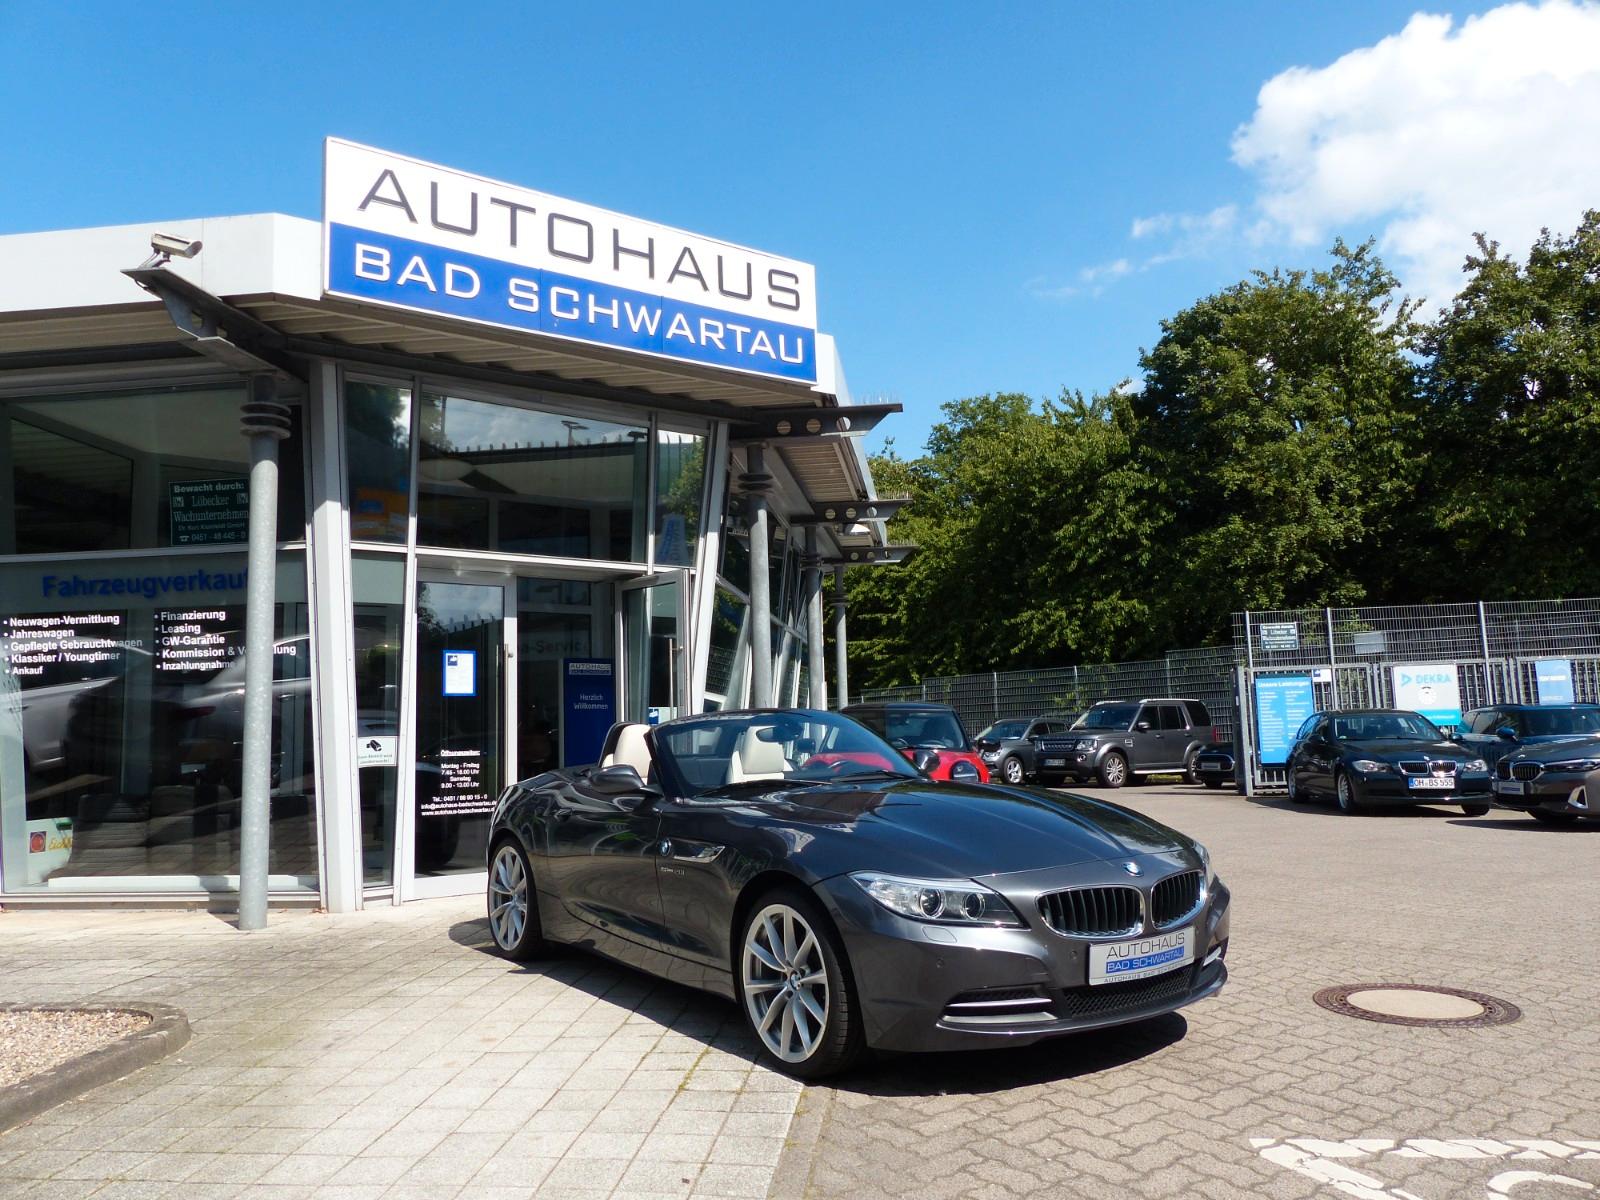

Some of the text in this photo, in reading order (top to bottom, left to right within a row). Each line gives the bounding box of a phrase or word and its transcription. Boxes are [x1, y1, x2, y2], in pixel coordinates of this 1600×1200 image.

[357, 168, 801, 312] AUTOHAUS
[355, 243, 804, 364] BAD SCHWARTAU
[173, 483, 214, 493] Bewacht
[9, 614, 120, 628] Neuwagen-Vermittlung
[160, 610, 226, 621] Finanzierung
[9, 629, 75, 639] Jahreswagen
[161, 623, 201, 634] Leasing
[10, 638, 143, 653] Gepflegte Gebrauchtwagen
[162, 635, 226, 646] GW-Garantie
[11, 652, 57, 664] Klassiker
[64, 651, 121, 663] Youngtimer
[162, 647, 225, 659] Kommission
[227, 646, 236, 656] &
[12, 665, 44, 675] Ankauf
[1415, 674, 1452, 684] DEKRA
[420, 807, 496, 816] www.autohaus-badschwartau.d
[1106, 932, 1185, 959] AUTOHAUS
[1106, 960, 1130, 973] BAD
[1132, 948, 1185, 968] SCHWARTAU
